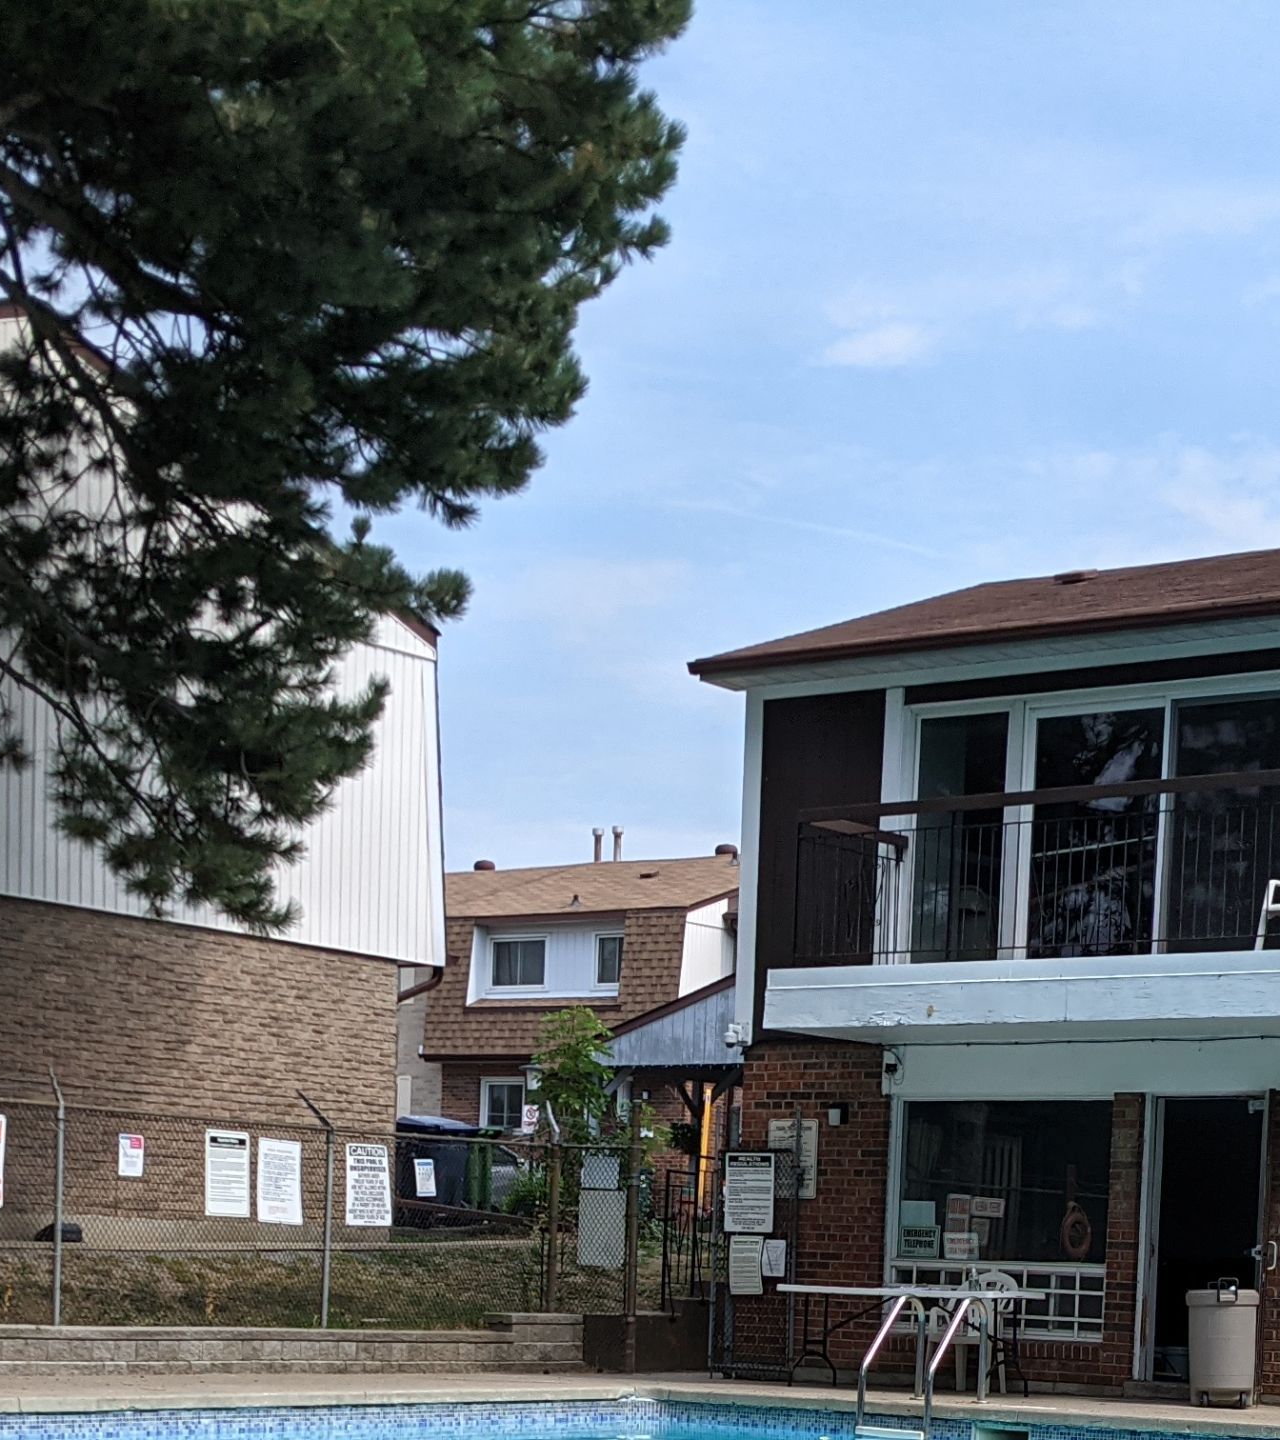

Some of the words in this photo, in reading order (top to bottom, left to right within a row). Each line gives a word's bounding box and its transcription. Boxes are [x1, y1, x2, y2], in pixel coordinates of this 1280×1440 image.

[350, 1146, 385, 1157] CAUTION
[903, 1229, 936, 1238] EMERGENCY
[904, 1239, 934, 1248] TELEPHONE
